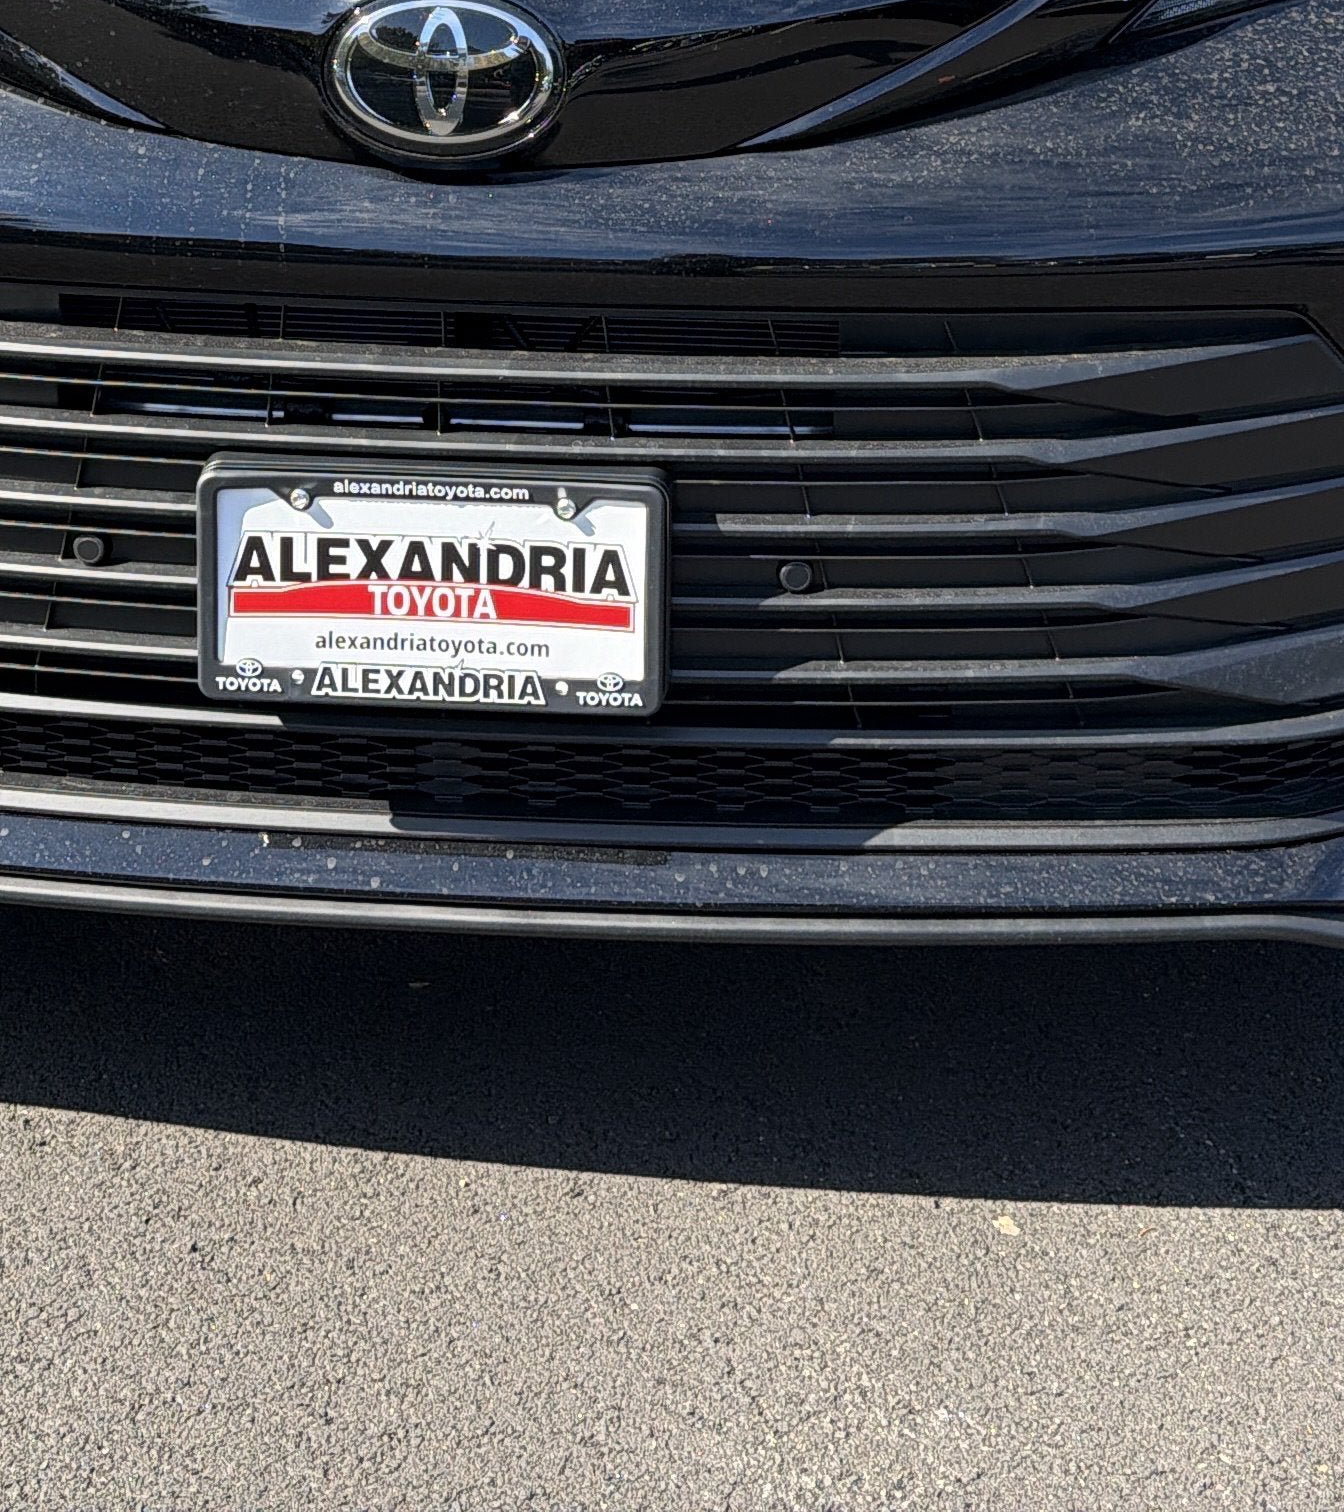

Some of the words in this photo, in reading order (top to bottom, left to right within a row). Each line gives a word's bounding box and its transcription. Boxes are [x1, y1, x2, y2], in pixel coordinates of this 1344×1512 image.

[333, 479, 530, 500] alexandriatoyota.com
[232, 535, 631, 597] ALEXANDRIA
[367, 584, 498, 619] TOYOTA
[315, 630, 550, 658] alexandriatoyota.com
[215, 676, 283, 693] TOYOTA
[314, 665, 543, 702] ALEXANDRIA
[575, 691, 644, 707] TOYOTA
